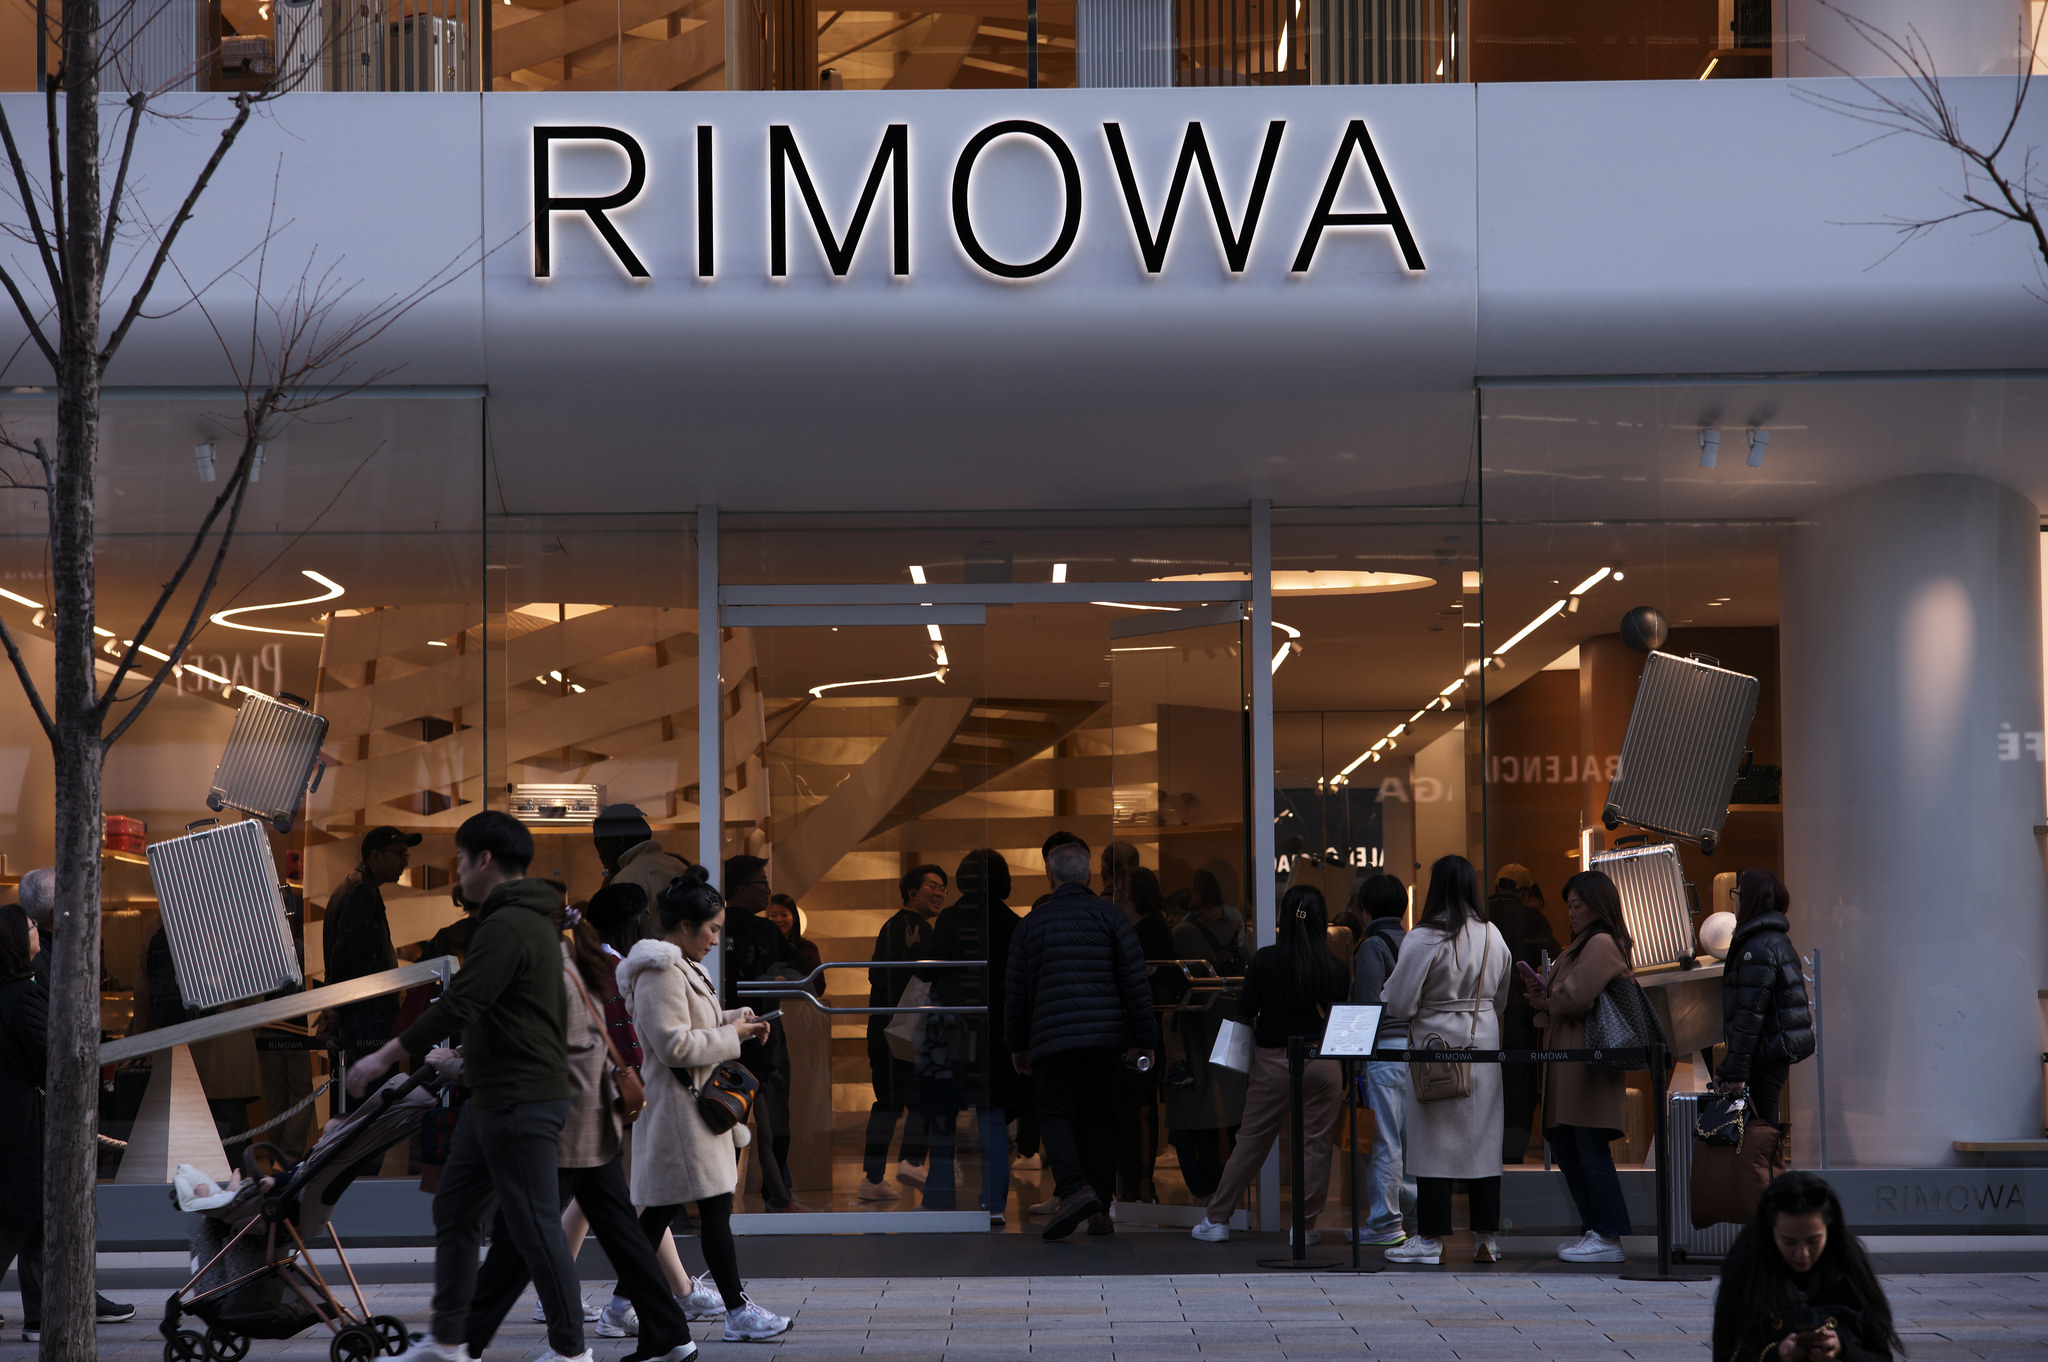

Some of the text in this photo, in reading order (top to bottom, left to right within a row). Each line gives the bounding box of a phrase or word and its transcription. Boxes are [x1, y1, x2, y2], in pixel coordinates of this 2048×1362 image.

[533, 120, 1426, 279] RIMOWA
[268, 1041, 302, 1049] RIMOWA
[1435, 1053, 1473, 1061] RIMOWA
[1530, 1052, 1569, 1060] RIMOWA
[1876, 1184, 2028, 1212] RIMOWA
